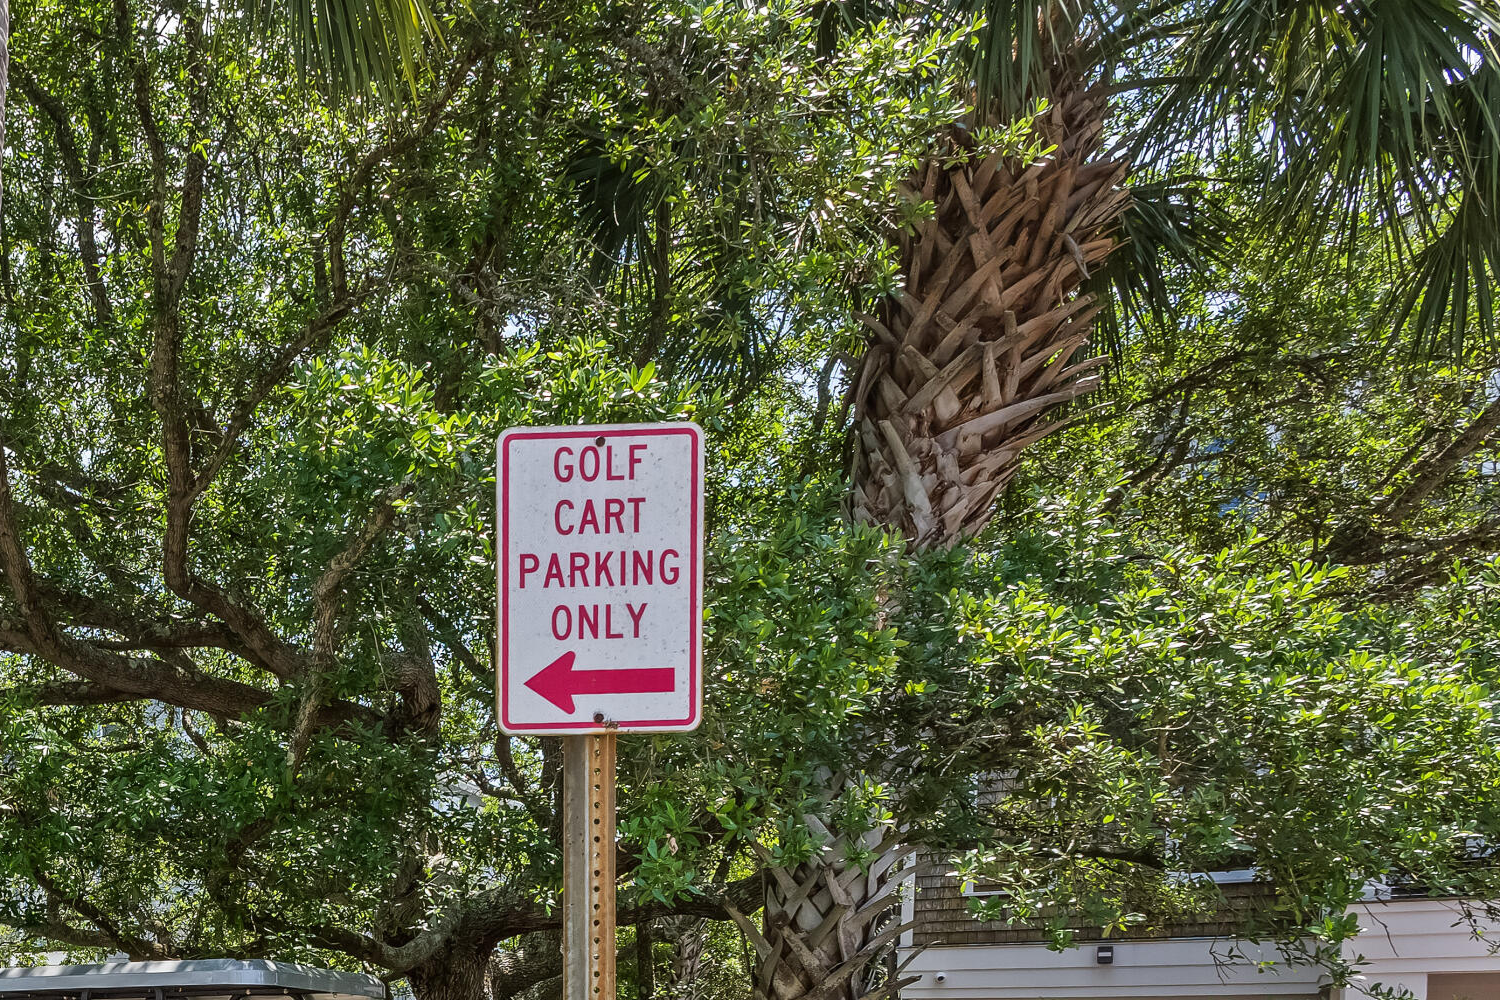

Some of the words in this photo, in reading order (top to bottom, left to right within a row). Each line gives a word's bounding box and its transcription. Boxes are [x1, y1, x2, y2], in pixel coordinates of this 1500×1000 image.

[553, 444, 648, 483] GOLF
[554, 497, 646, 536] CART
[519, 549, 680, 589] PARKING
[551, 602, 648, 641] ONLY
